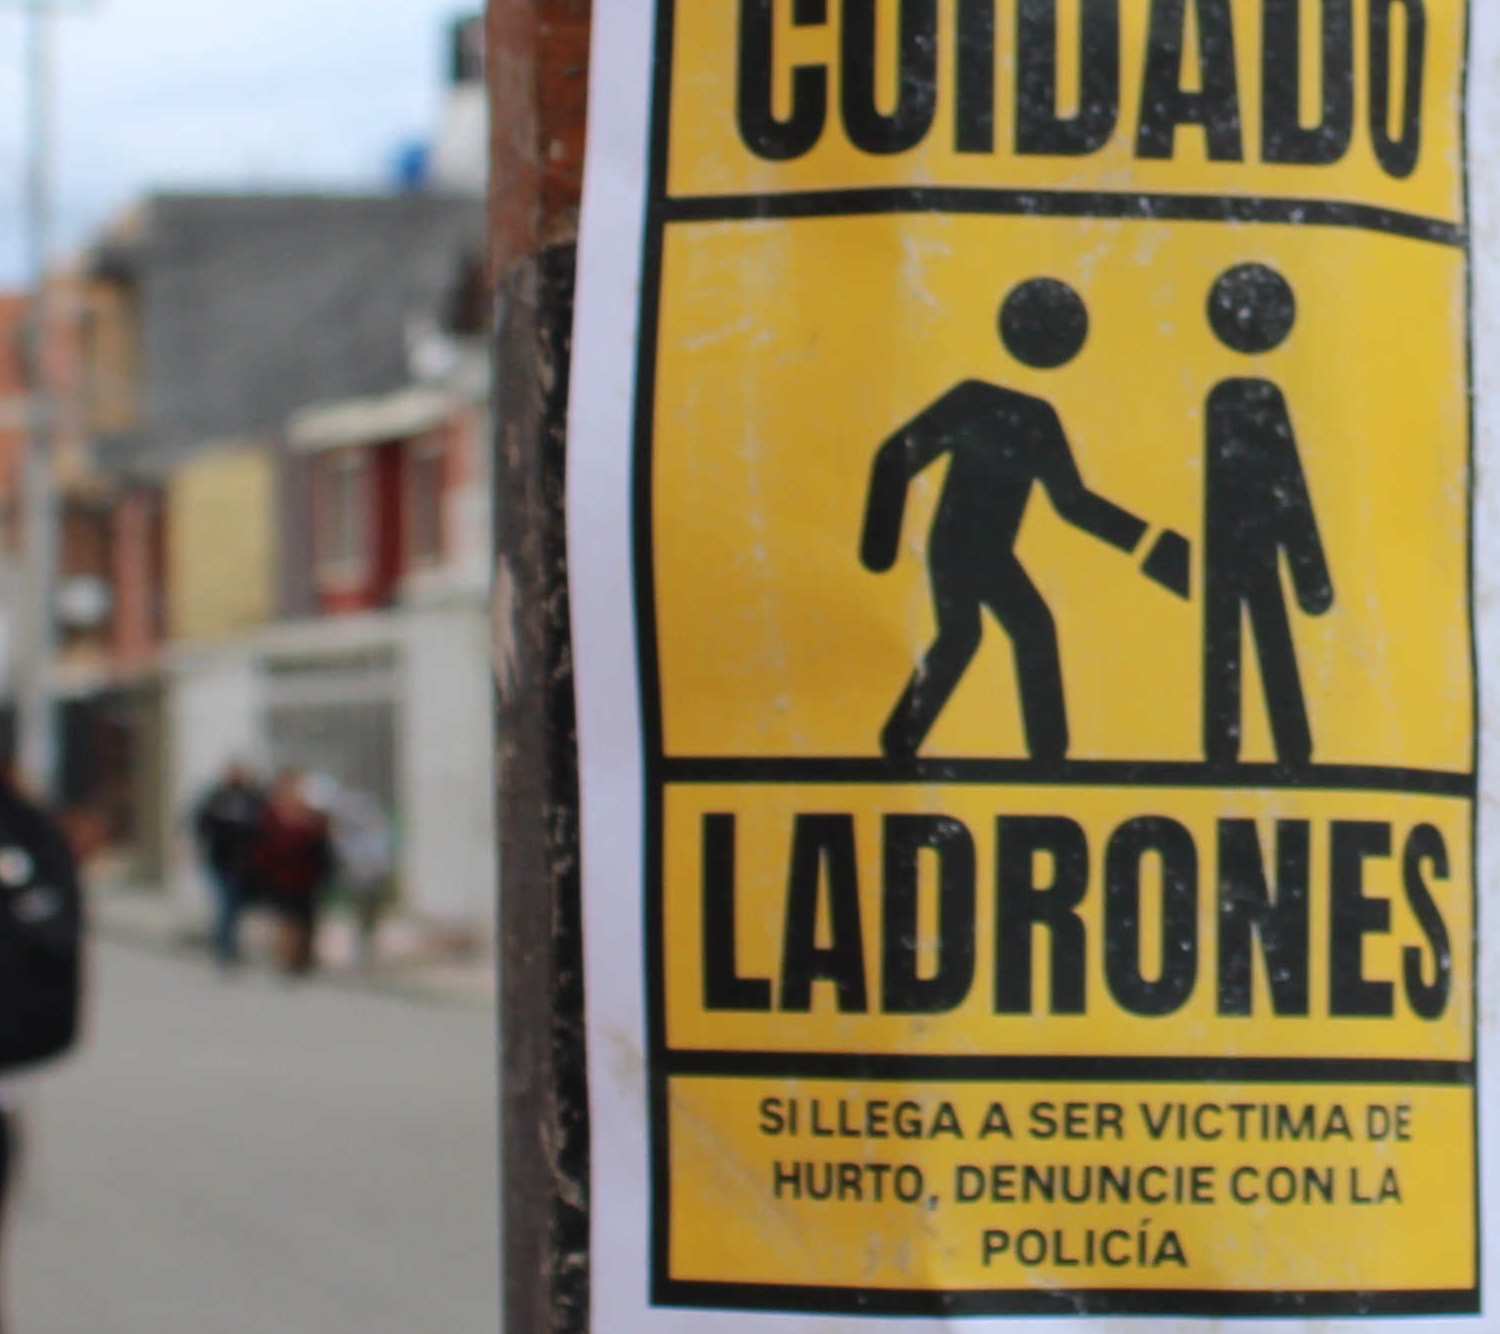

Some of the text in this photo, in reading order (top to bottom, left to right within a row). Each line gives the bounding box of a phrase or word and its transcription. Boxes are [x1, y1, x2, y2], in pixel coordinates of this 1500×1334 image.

[700, 812, 1452, 1022] LADRONES
[758, 1097, 1412, 1142] SI LLEGA A SER VICTIMA DE
[773, 1161, 1403, 1210] HURTO, DENUNCIE CON LA
[981, 1218, 1188, 1268] POLICÍA
